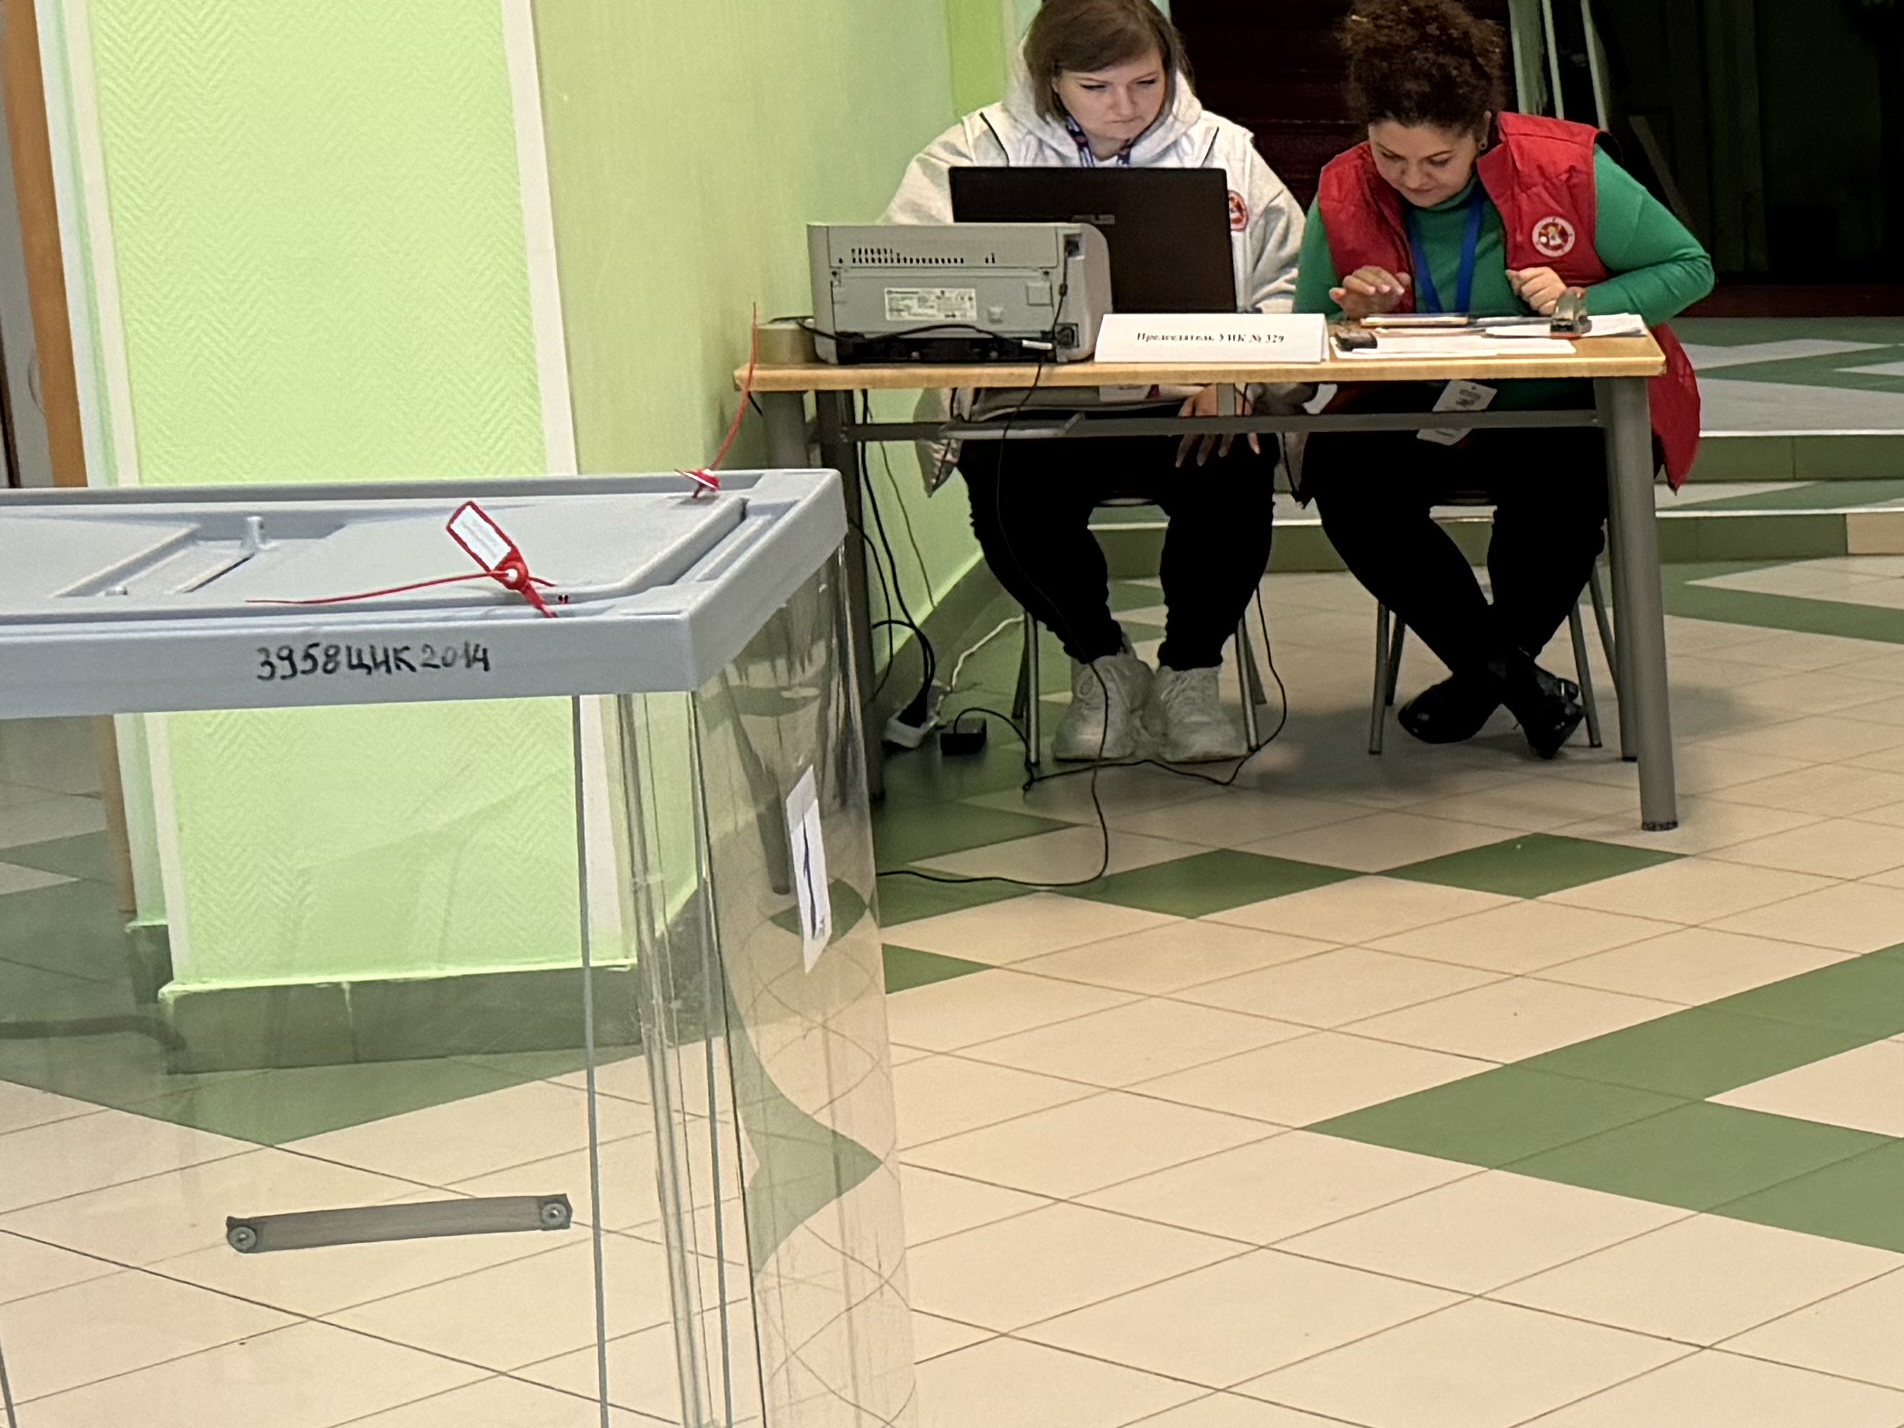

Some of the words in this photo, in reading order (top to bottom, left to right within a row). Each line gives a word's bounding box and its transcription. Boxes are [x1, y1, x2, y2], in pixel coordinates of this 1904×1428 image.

[1136, 332, 1215, 343] Председатель
[1218, 332, 1246, 343] УИК
[1248, 333, 1262, 343] №
[1265, 334, 1285, 343] 329
